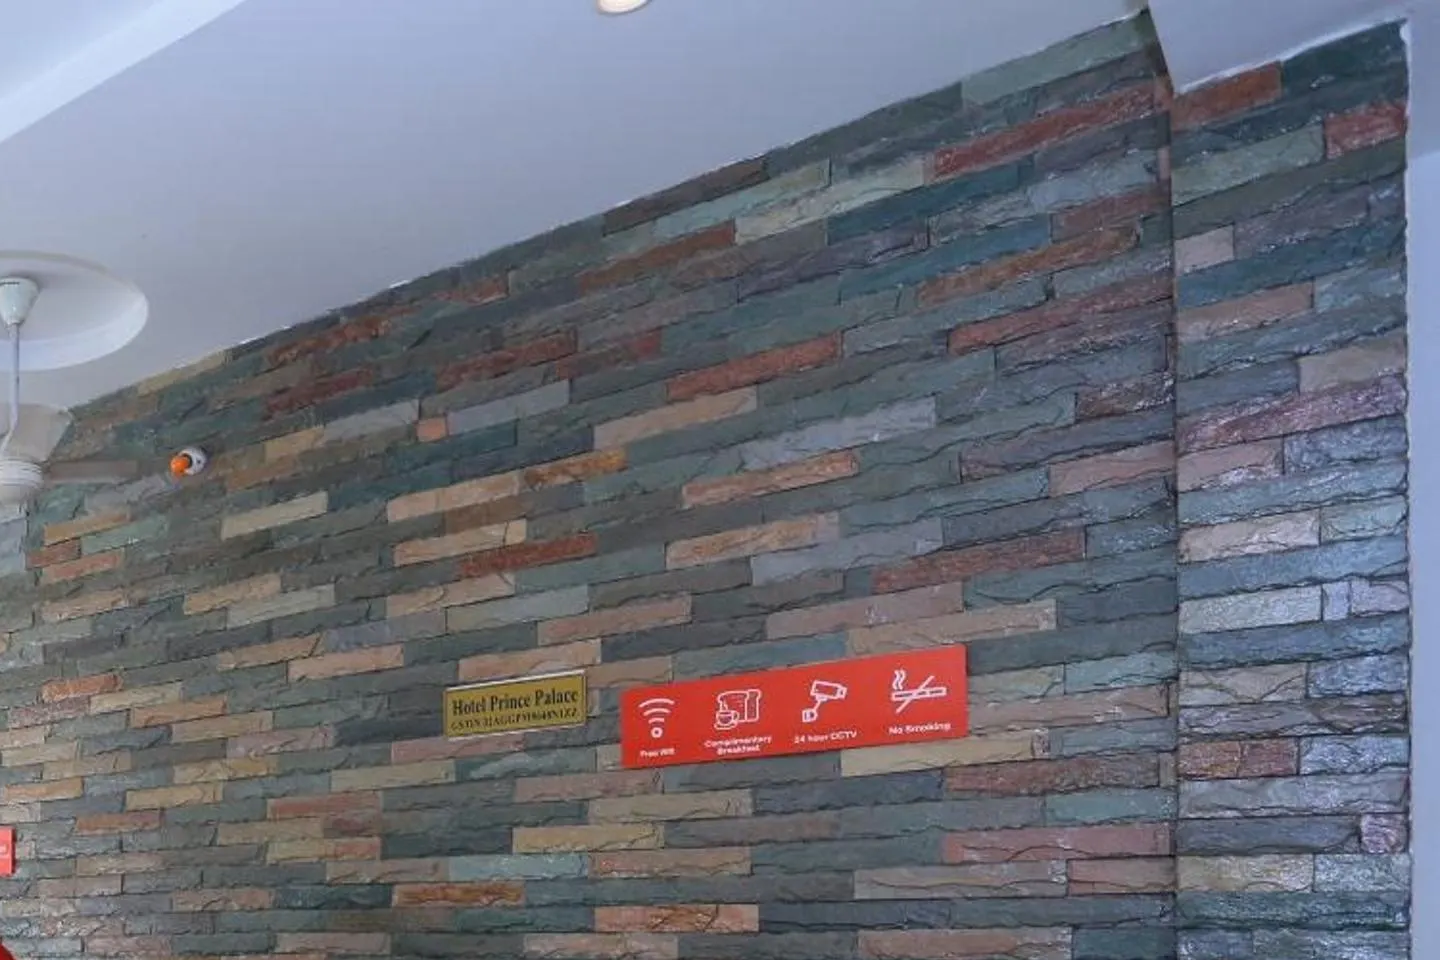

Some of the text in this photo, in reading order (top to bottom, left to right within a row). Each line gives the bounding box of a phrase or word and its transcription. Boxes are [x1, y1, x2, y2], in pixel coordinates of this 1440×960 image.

[452, 688, 579, 716] Hotel Prince Palace
[888, 722, 952, 735] No Smoking
[830, 730, 858, 740] CCTV
[640, 748, 658, 758] Free
